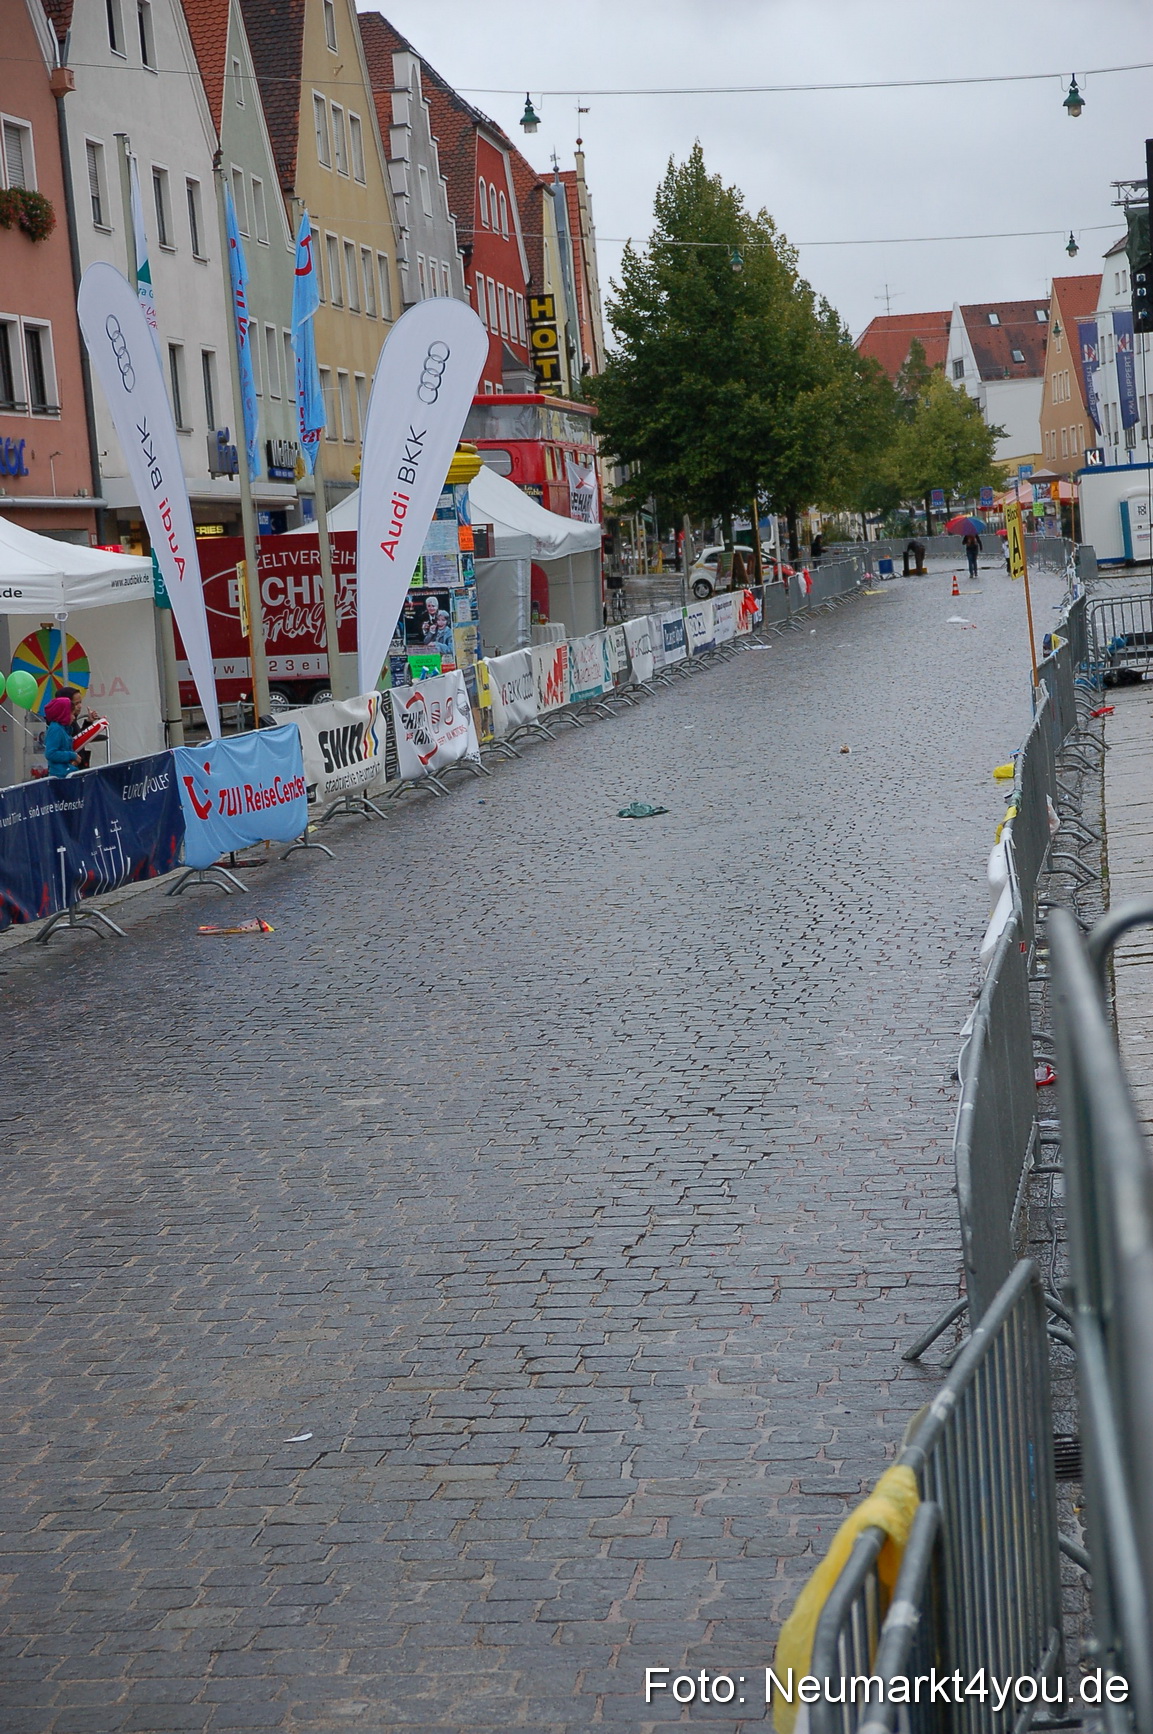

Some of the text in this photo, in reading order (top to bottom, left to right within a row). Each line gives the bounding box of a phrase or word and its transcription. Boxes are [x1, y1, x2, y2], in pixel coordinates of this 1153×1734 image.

[1125, 356, 1135, 397] RUPPERT
[380, 425, 427, 561] Audi BKK
[256, 550, 356, 570] ZELTVEREIH
[1012, 527, 1021, 563] A
[29, 804, 39, 819] sind
[218, 786, 242, 816] TUI
